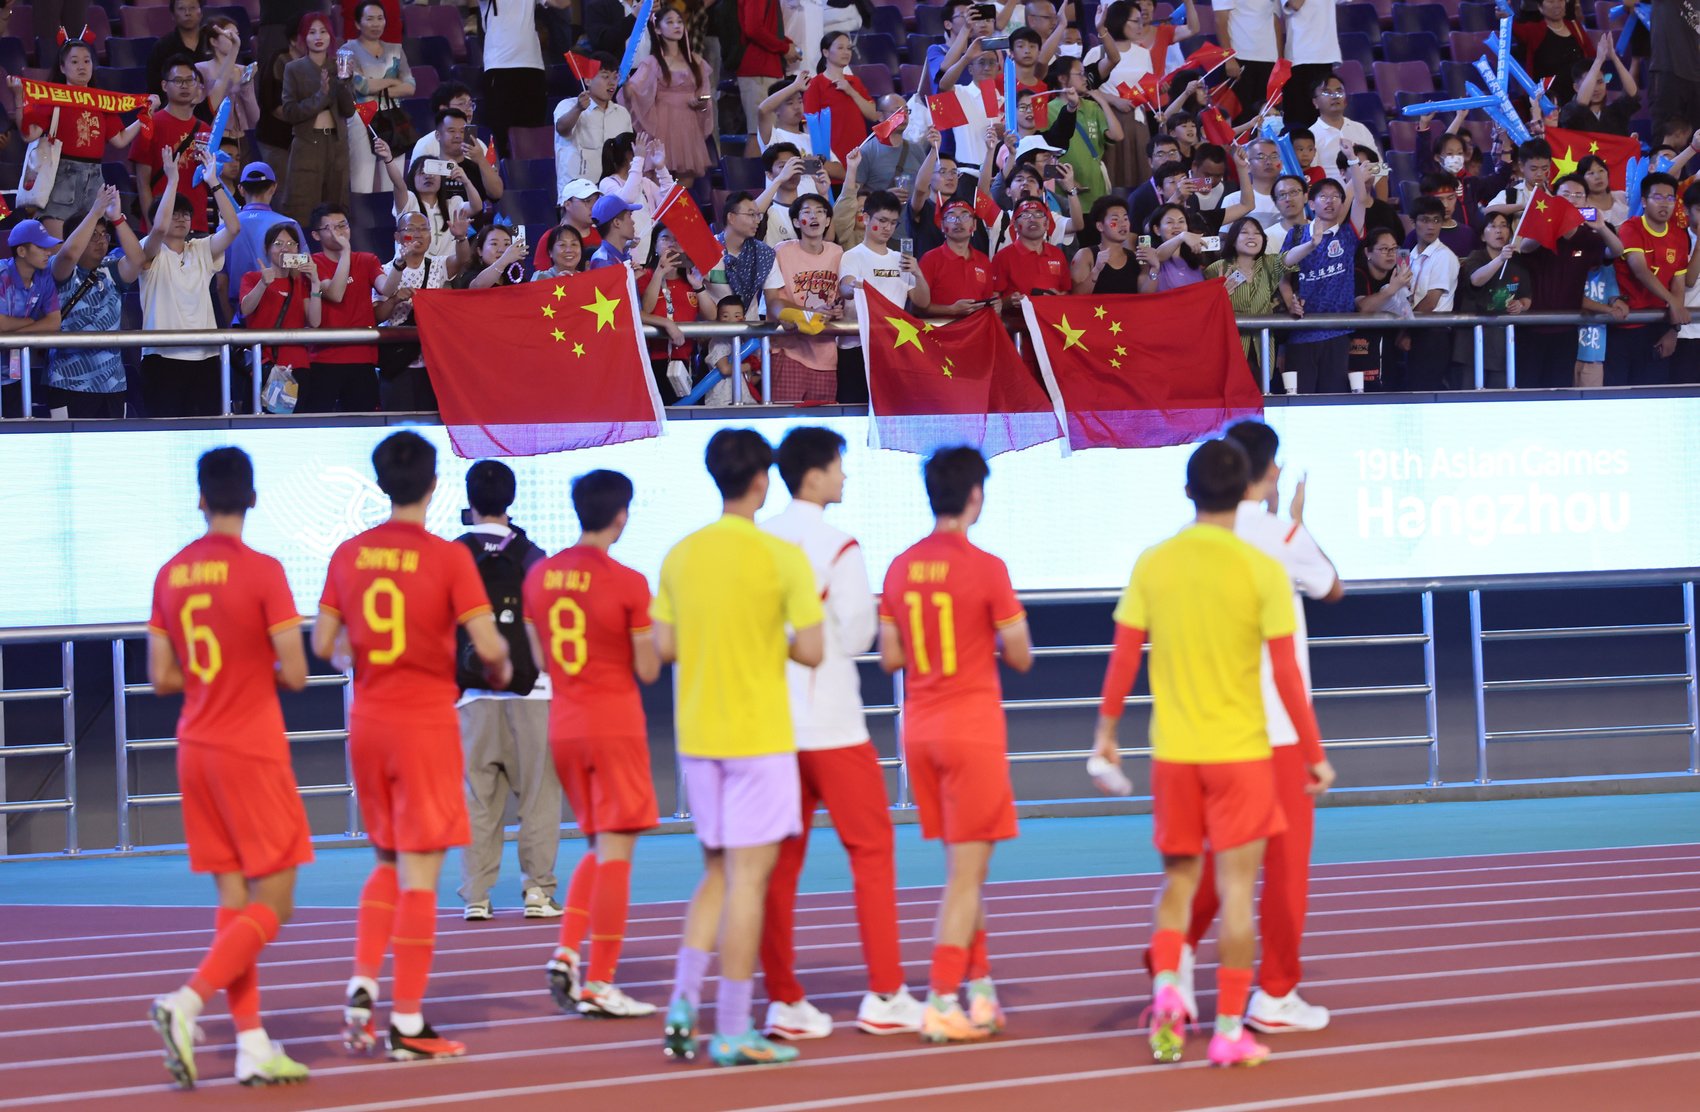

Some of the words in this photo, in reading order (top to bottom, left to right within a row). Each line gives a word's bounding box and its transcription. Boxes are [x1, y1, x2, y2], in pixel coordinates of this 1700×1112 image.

[26, 81, 137, 112] 中国队加油
[1353, 447, 1422, 480] 19th
[1430, 446, 1517, 479] Asian
[1521, 445, 1631, 477] Games
[1357, 481, 1631, 546] Hangzhou
[180, 592, 222, 684] 6
[362, 577, 406, 665] 9
[548, 596, 588, 676] 8
[903, 590, 957, 676] 11
